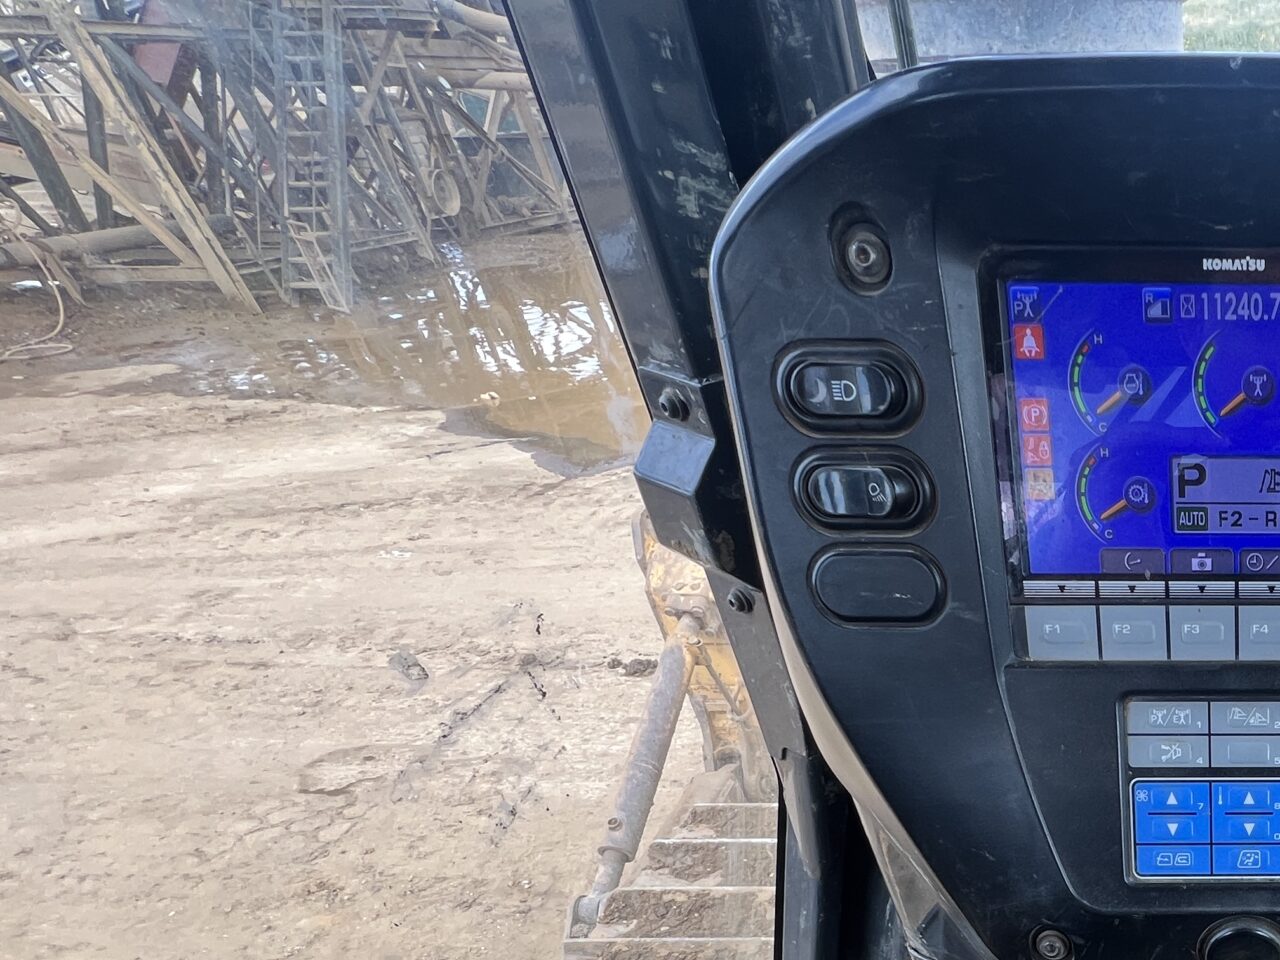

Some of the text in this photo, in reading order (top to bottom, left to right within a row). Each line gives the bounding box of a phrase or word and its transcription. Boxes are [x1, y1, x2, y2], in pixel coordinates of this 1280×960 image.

[1202, 256, 1265, 272] KOMATSU
[1093, 335, 1103, 344] H
[1098, 423, 1107, 433] C
[1100, 448, 1109, 457] H
[1177, 462, 1207, 499] P
[1179, 511, 1206, 526] AUTO
[1104, 529, 1113, 539] C
[1044, 624, 1061, 635] F1
[1114, 624, 1131, 635] F2
[1183, 624, 1200, 635] F3
[1252, 624, 1269, 635] F4
[1196, 721, 1202, 729] 1
[1274, 721, 1280, 729] 2
[1197, 802, 1204, 810] 7
[1274, 802, 1280, 810] 8
